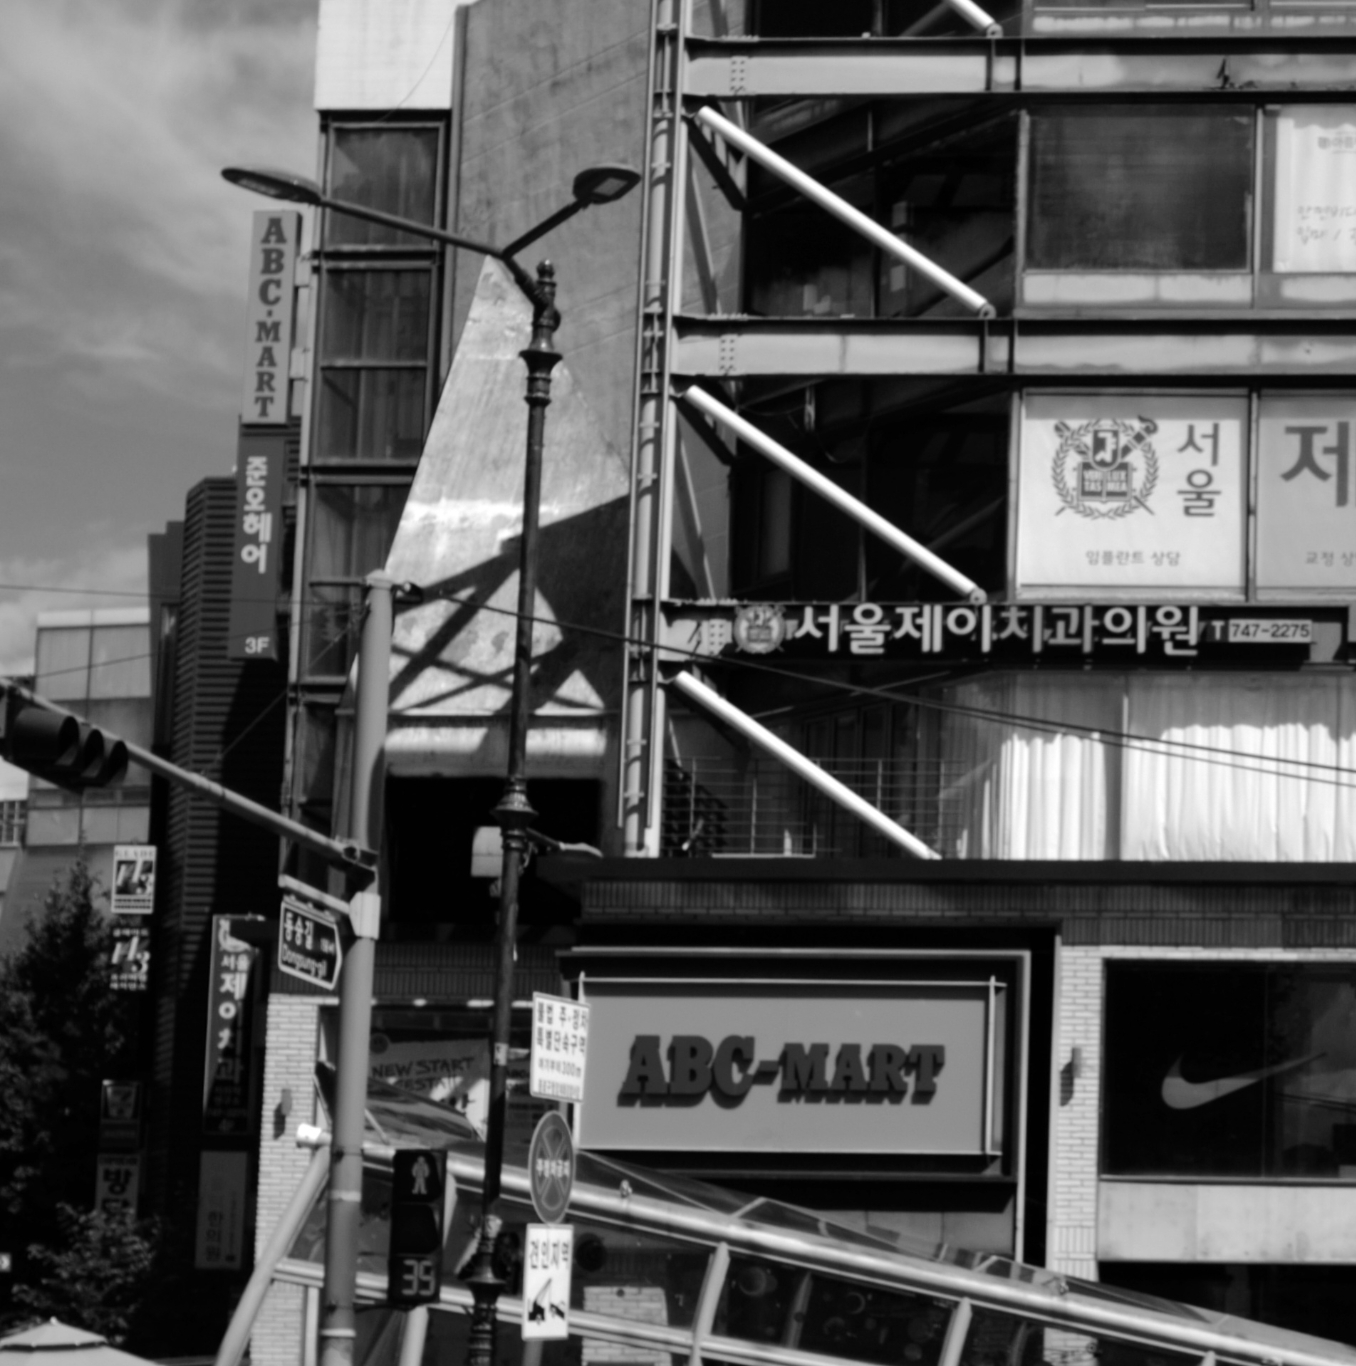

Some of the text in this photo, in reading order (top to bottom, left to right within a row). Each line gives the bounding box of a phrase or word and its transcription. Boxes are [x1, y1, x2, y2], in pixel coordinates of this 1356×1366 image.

[1177, 422, 1222, 517] 서울
[1150, 550, 1181, 566] 상담
[1305, 551, 1334, 567] 교정
[794, 602, 1199, 655] 서울제이치과의원
[1230, 622, 1312, 640] 747-2275
[244, 636, 269, 654] 3F
[371, 1056, 475, 1078] NEW START
[616, 1034, 946, 1109] ABC-MART
